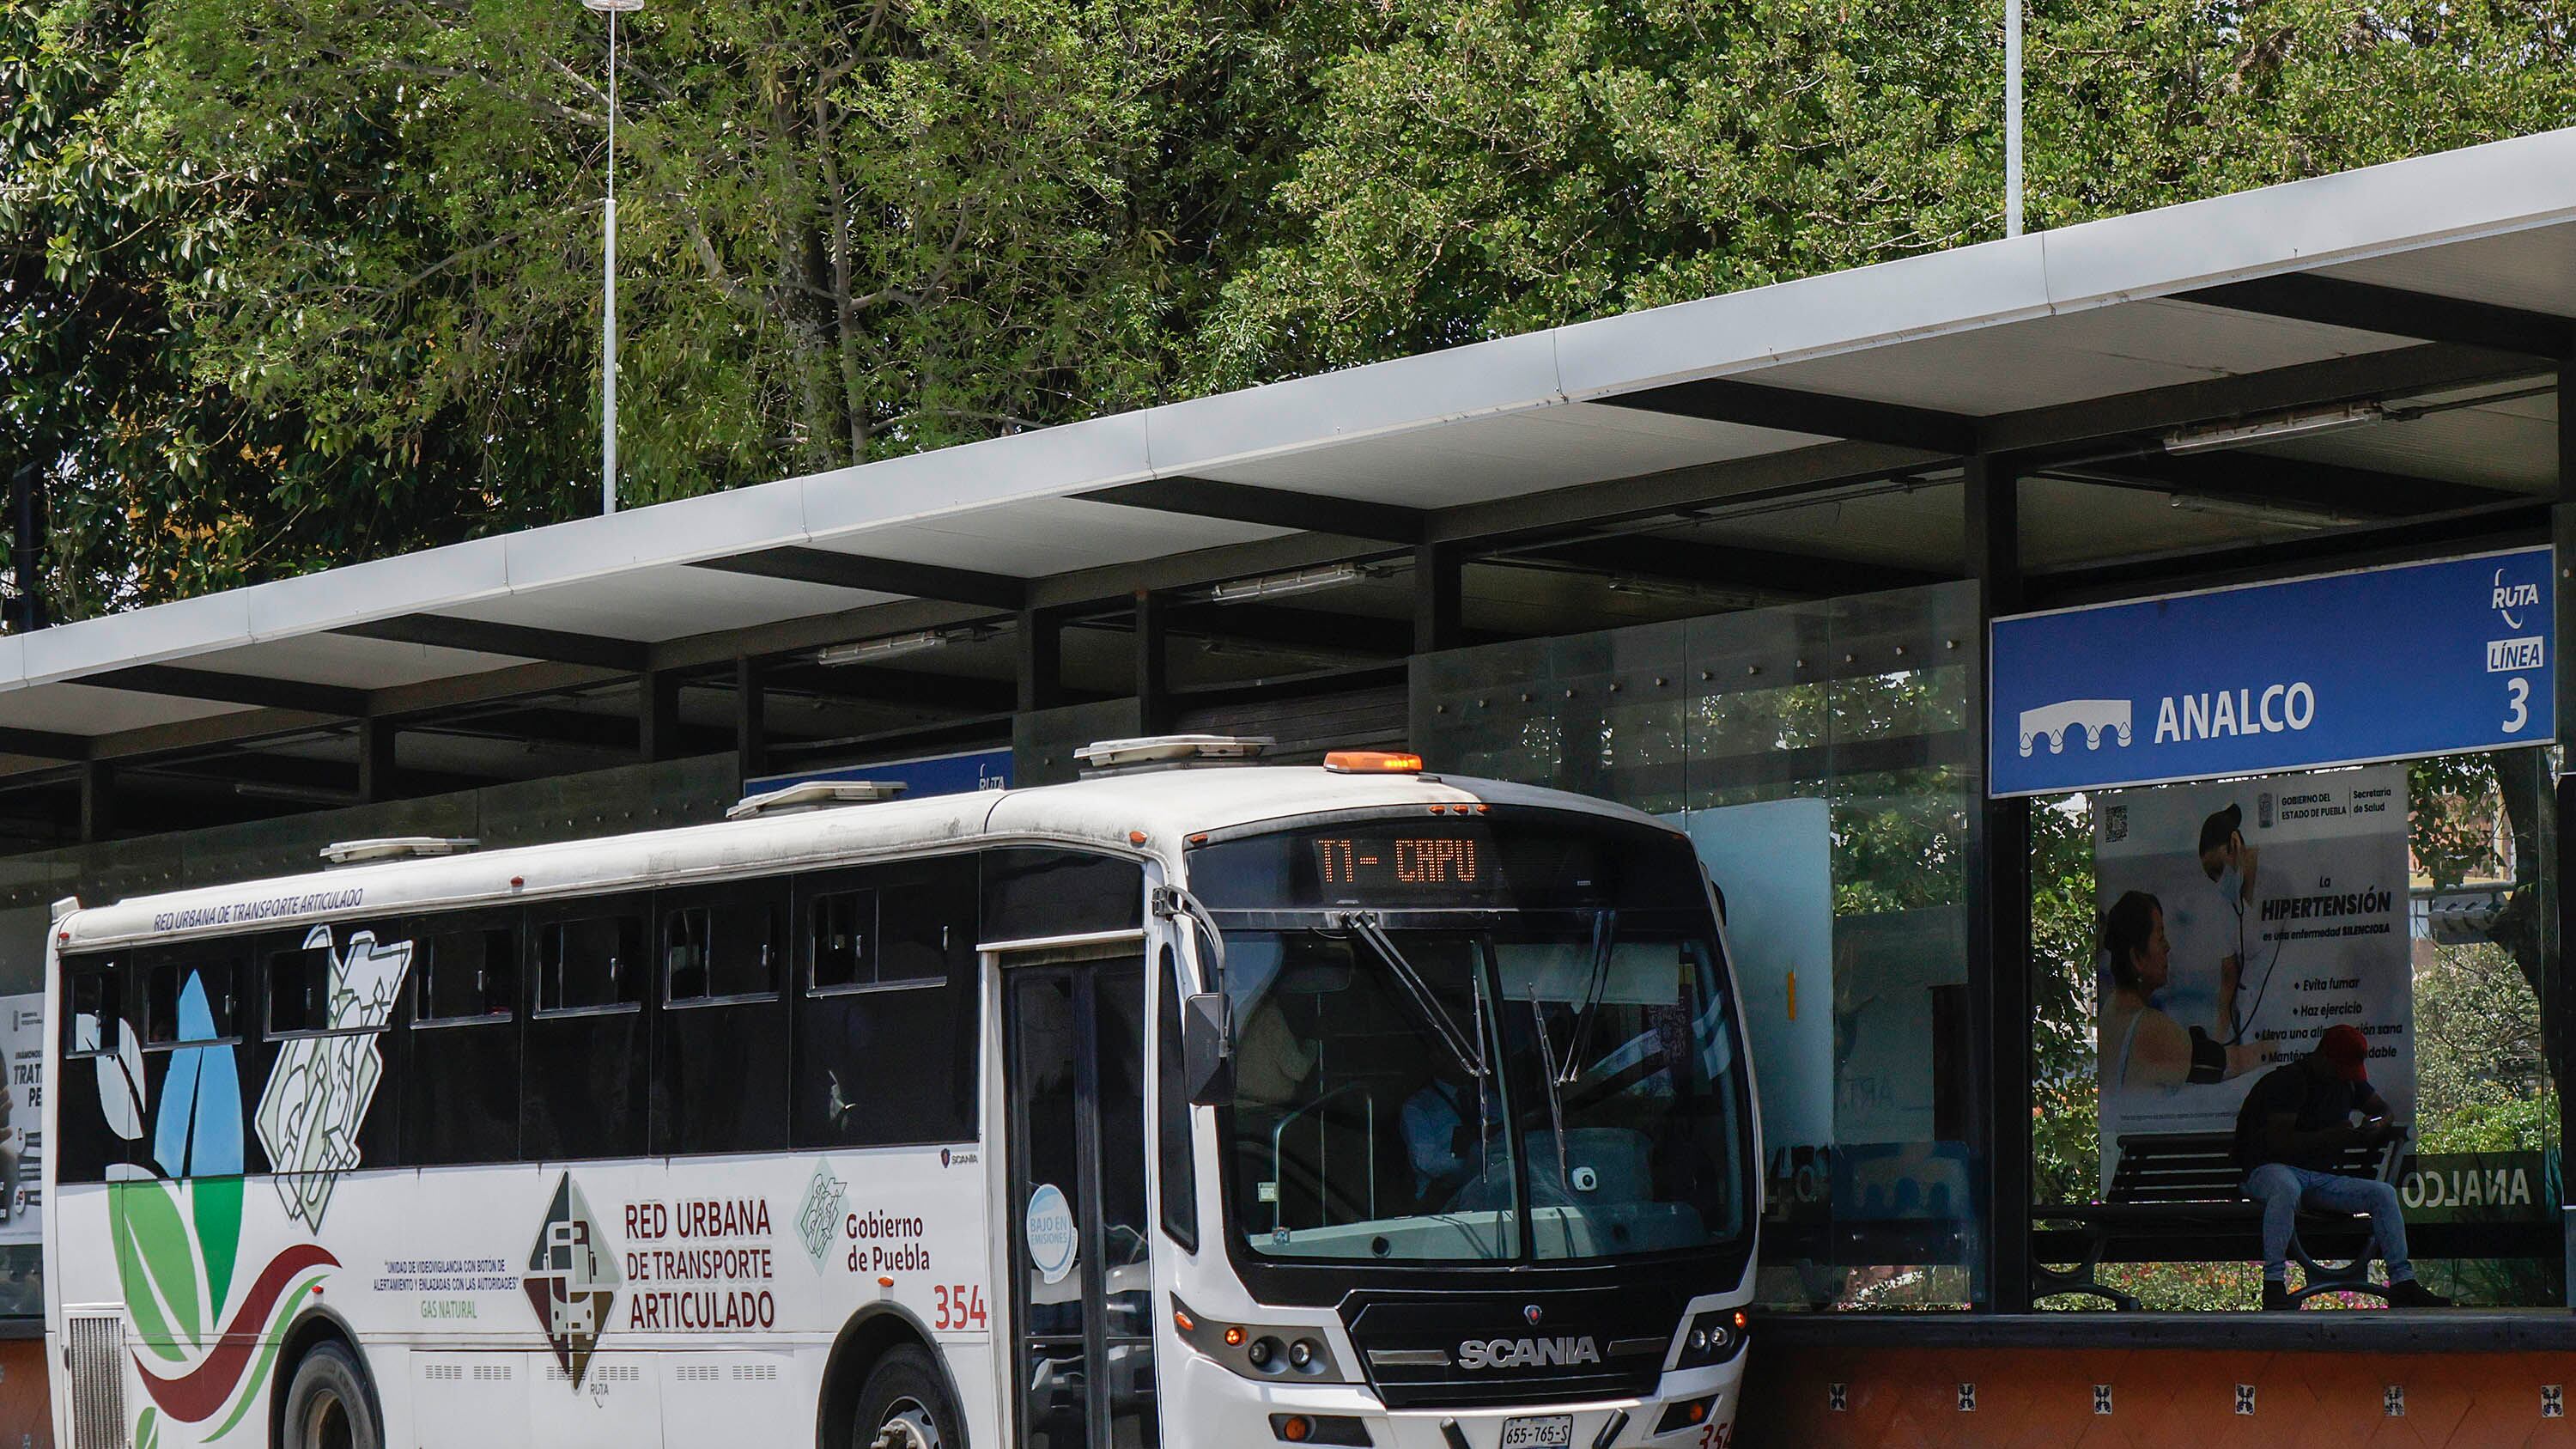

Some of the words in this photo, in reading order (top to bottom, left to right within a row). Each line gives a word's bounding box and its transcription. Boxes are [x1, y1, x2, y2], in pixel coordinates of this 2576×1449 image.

[2493, 583, 2539, 610] RUTA
[2491, 642, 2540, 669] LÍNEA
[2154, 681, 2315, 744] ANALCO
[2502, 677, 2530, 734] 3
[2281, 795, 2318, 806] GOBIERNO
[2319, 793, 2330, 803] DEL
[2353, 786, 2391, 799] Secretaría
[2281, 807, 2309, 820] ESTADO
[2311, 807, 2319, 818] DE
[2320, 806, 2347, 817] PUEBLA
[2353, 804, 2363, 813] de
[2364, 802, 2385, 813] Salud
[1395, 839, 1476, 882] CAPU
[2319, 876, 2330, 888] La
[154, 913, 173, 931] RED
[175, 906, 216, 928] URBANA
[217, 905, 231, 922] DE
[234, 897, 300, 922] TRANSPORTE
[300, 888, 363, 913] ARTICULADO
[2261, 885, 2391, 922] HIPERTENSIÓN
[2263, 932, 2272, 941] es
[2291, 926, 2341, 940] enfermedad
[2342, 922, 2391, 936] SILENCIOSA
[2303, 978, 2328, 991] Evita
[2329, 977, 2360, 989] fumar
[2300, 1005, 2319, 1017] Haz
[2320, 1001, 2363, 1019] ejercicio
[2289, 1029, 2309, 1039] una
[2377, 1023, 2403, 1035] sana
[14, 1063, 42, 1085] TRAT
[951, 1154, 978, 1164] SCANIA
[625, 1204, 667, 1239] RED
[677, 1199, 772, 1239] URBANA
[847, 1209, 923, 1239] Gobierno
[1030, 1216, 1053, 1233] BAJO
[1054, 1215, 1067, 1231] EN
[1030, 1232, 1067, 1245] EMISIONES
[408, 1261, 416, 1273] DE
[416, 1260, 462, 1274] VIDEOVIGILANCIA
[464, 1259, 476, 1273] CON
[477, 1256, 496, 1273] BOTÓN
[497, 1259, 505, 1272] DE
[627, 1252, 649, 1280] DE
[653, 1249, 772, 1280] TRANSPORTE
[848, 1245, 867, 1272] de
[872, 1243, 930, 1271] Puebla
[374, 1278, 413, 1291] ALERTAMIENTO
[419, 1277, 451, 1291] ENLAZADAS
[453, 1277, 465, 1290] CON
[465, 1277, 476, 1290] LAS
[421, 1300, 437, 1318] GAS
[439, 1300, 477, 1319] NATURAL
[630, 1290, 775, 1329] ARTICULADO
[934, 1285, 987, 1330] 354
[1458, 1336, 1601, 1369] SCANIA
[590, 1383, 609, 1395] RUTA
[1506, 1425, 1569, 1444] 655-765-S
